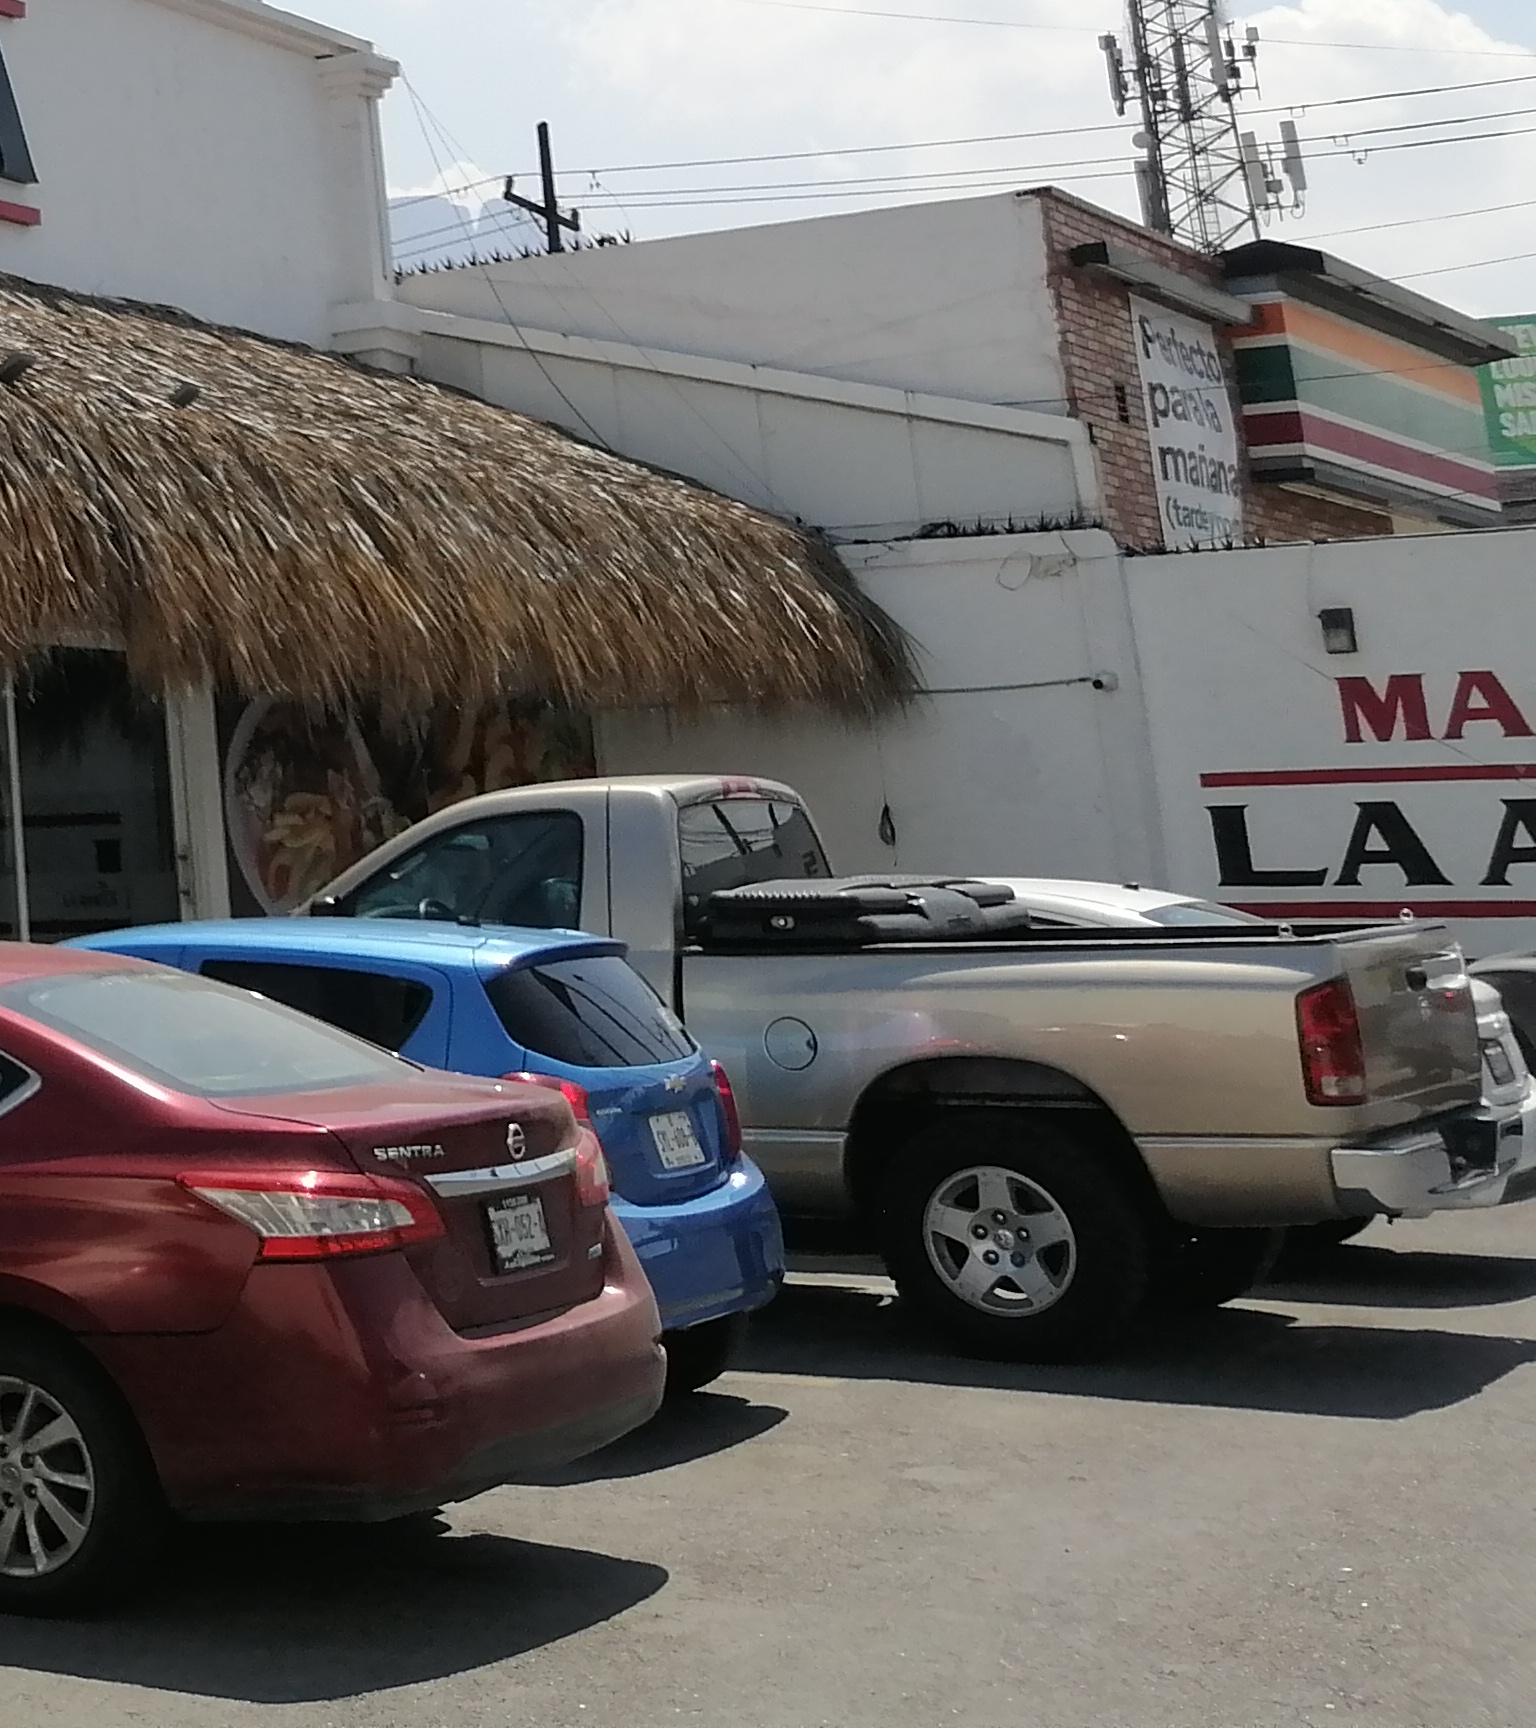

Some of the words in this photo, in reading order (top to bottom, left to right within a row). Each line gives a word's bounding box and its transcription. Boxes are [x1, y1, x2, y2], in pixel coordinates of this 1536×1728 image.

[1139, 314, 1222, 384] Perfecto
[1204, 800, 1454, 888] LA
[373, 1144, 445, 1162] SENTRA
